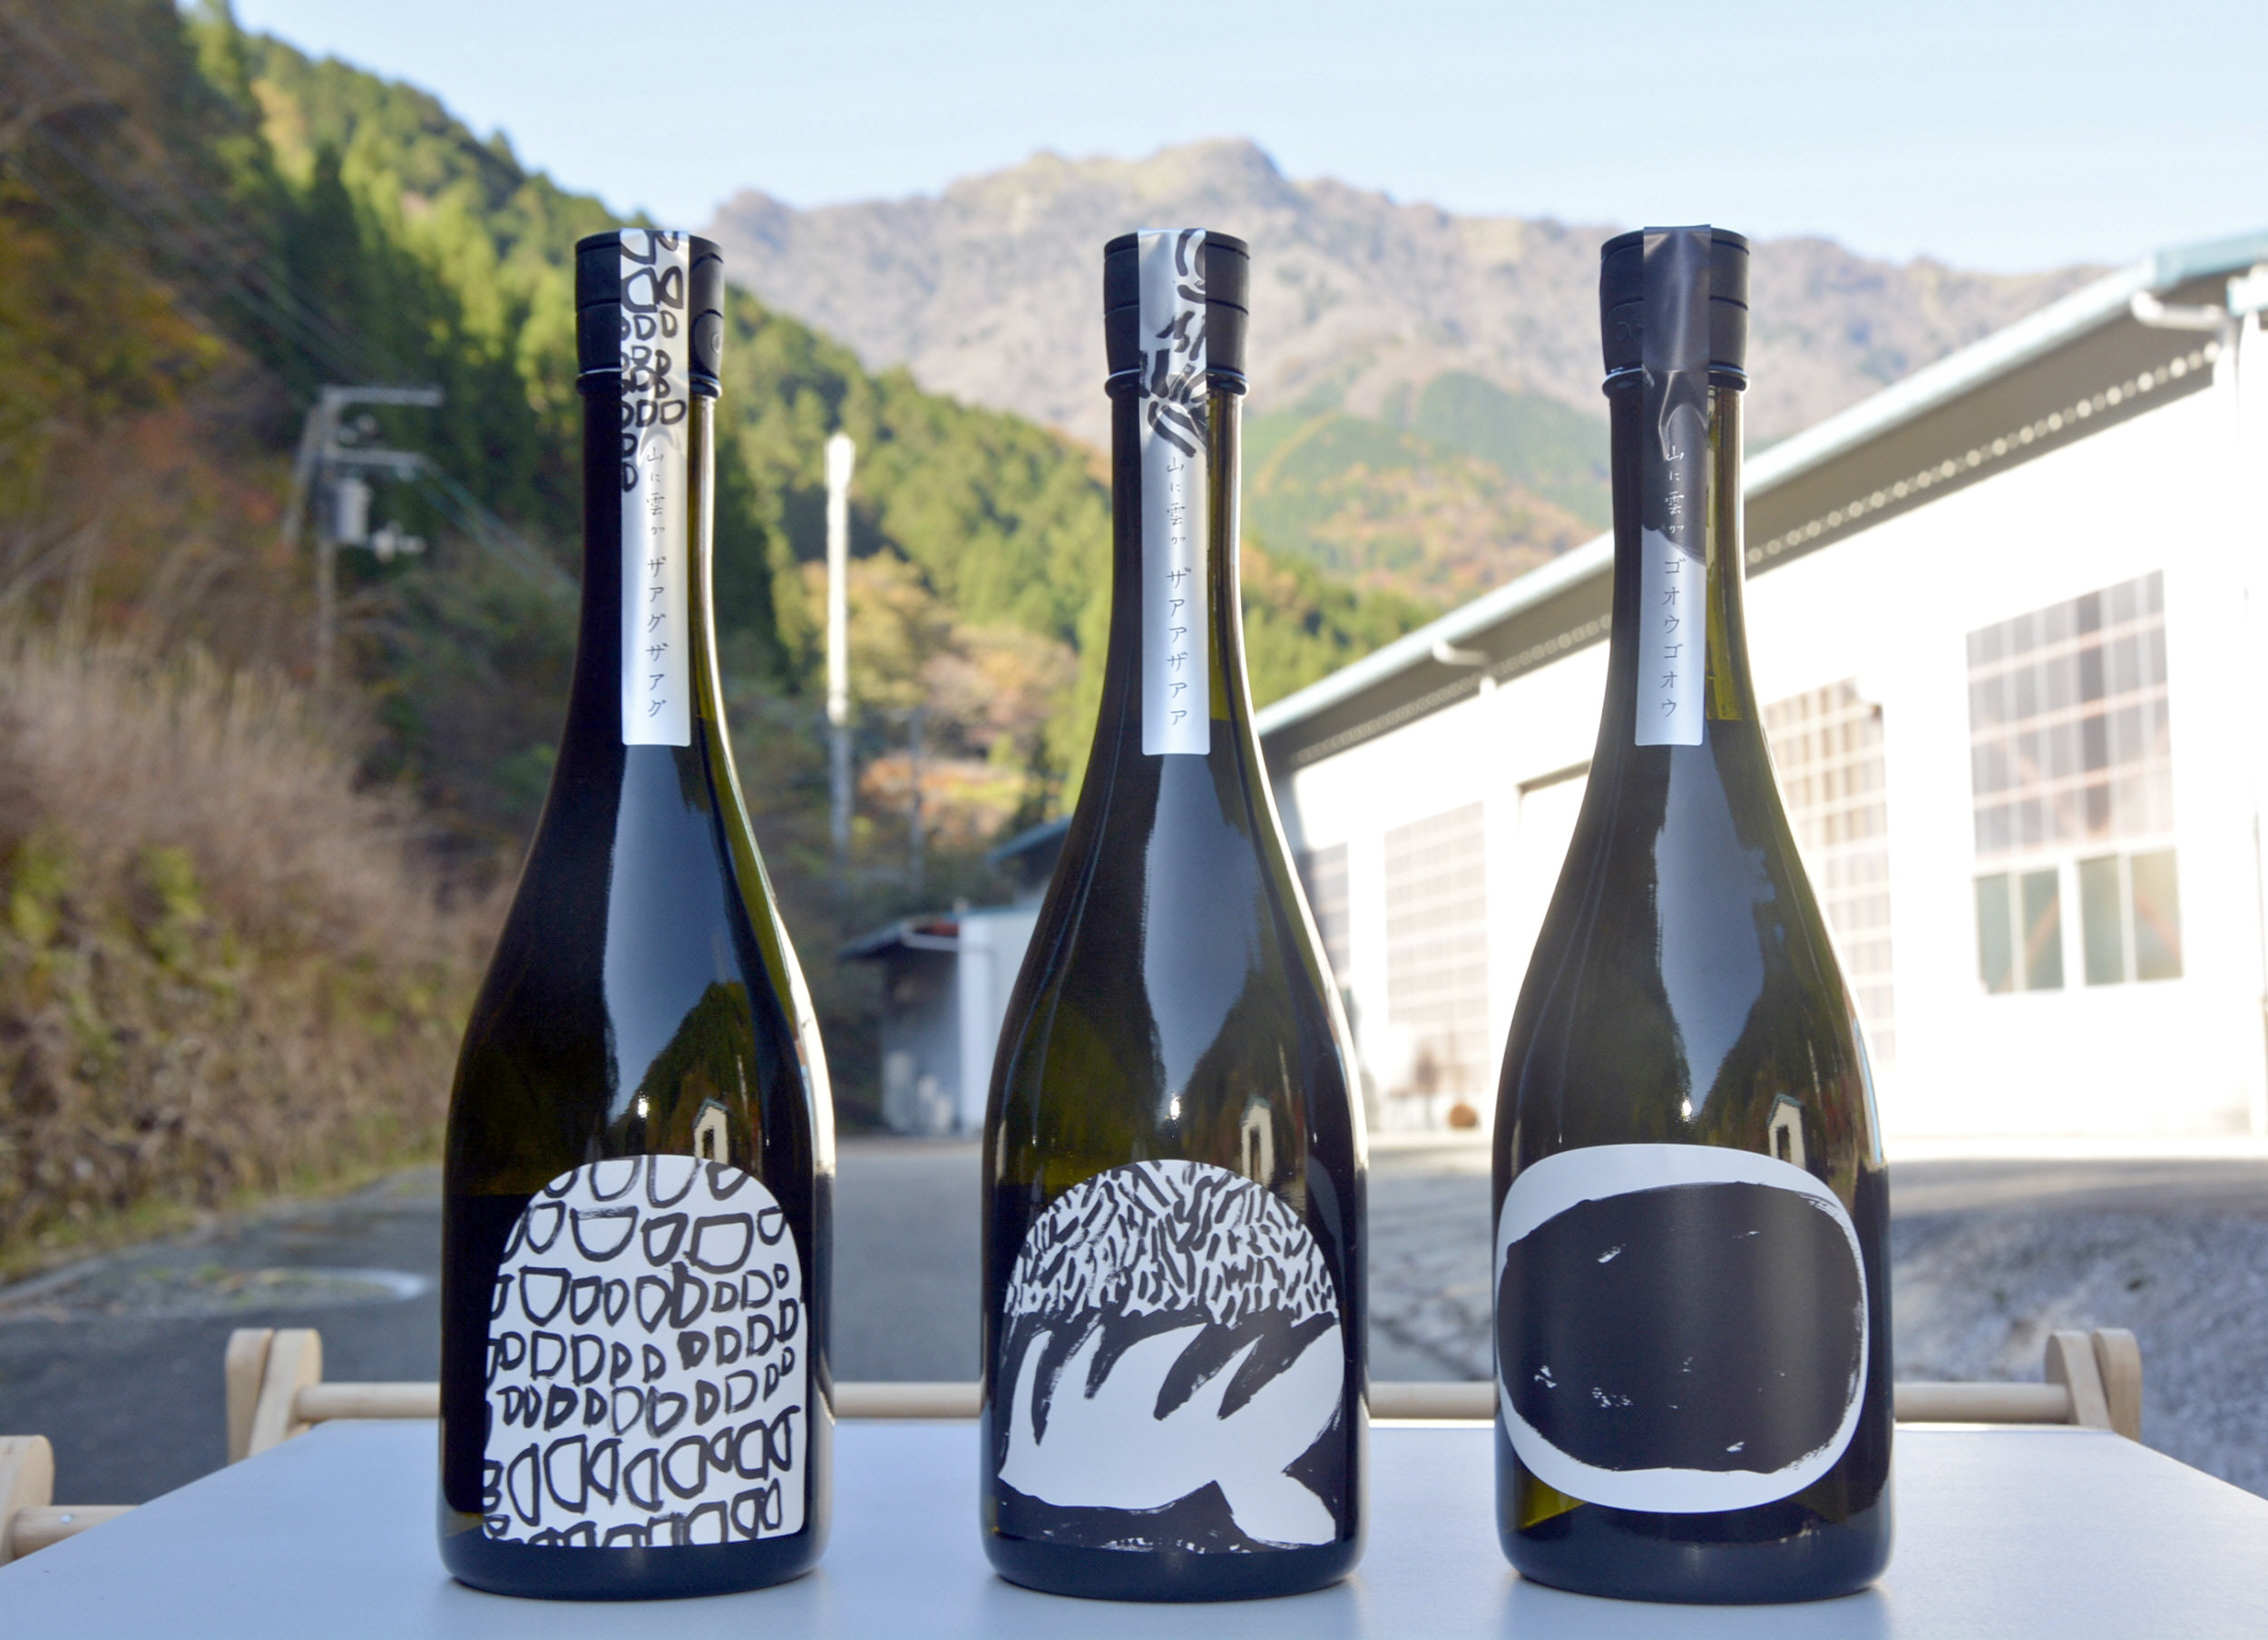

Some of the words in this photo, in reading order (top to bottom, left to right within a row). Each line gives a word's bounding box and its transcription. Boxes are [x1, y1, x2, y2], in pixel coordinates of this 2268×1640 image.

[646, 556, 670, 717] ザアグザアグ
[1167, 566, 1192, 725] ザアアザアア
[1660, 558, 1686, 717] ゴオウゴオウ
